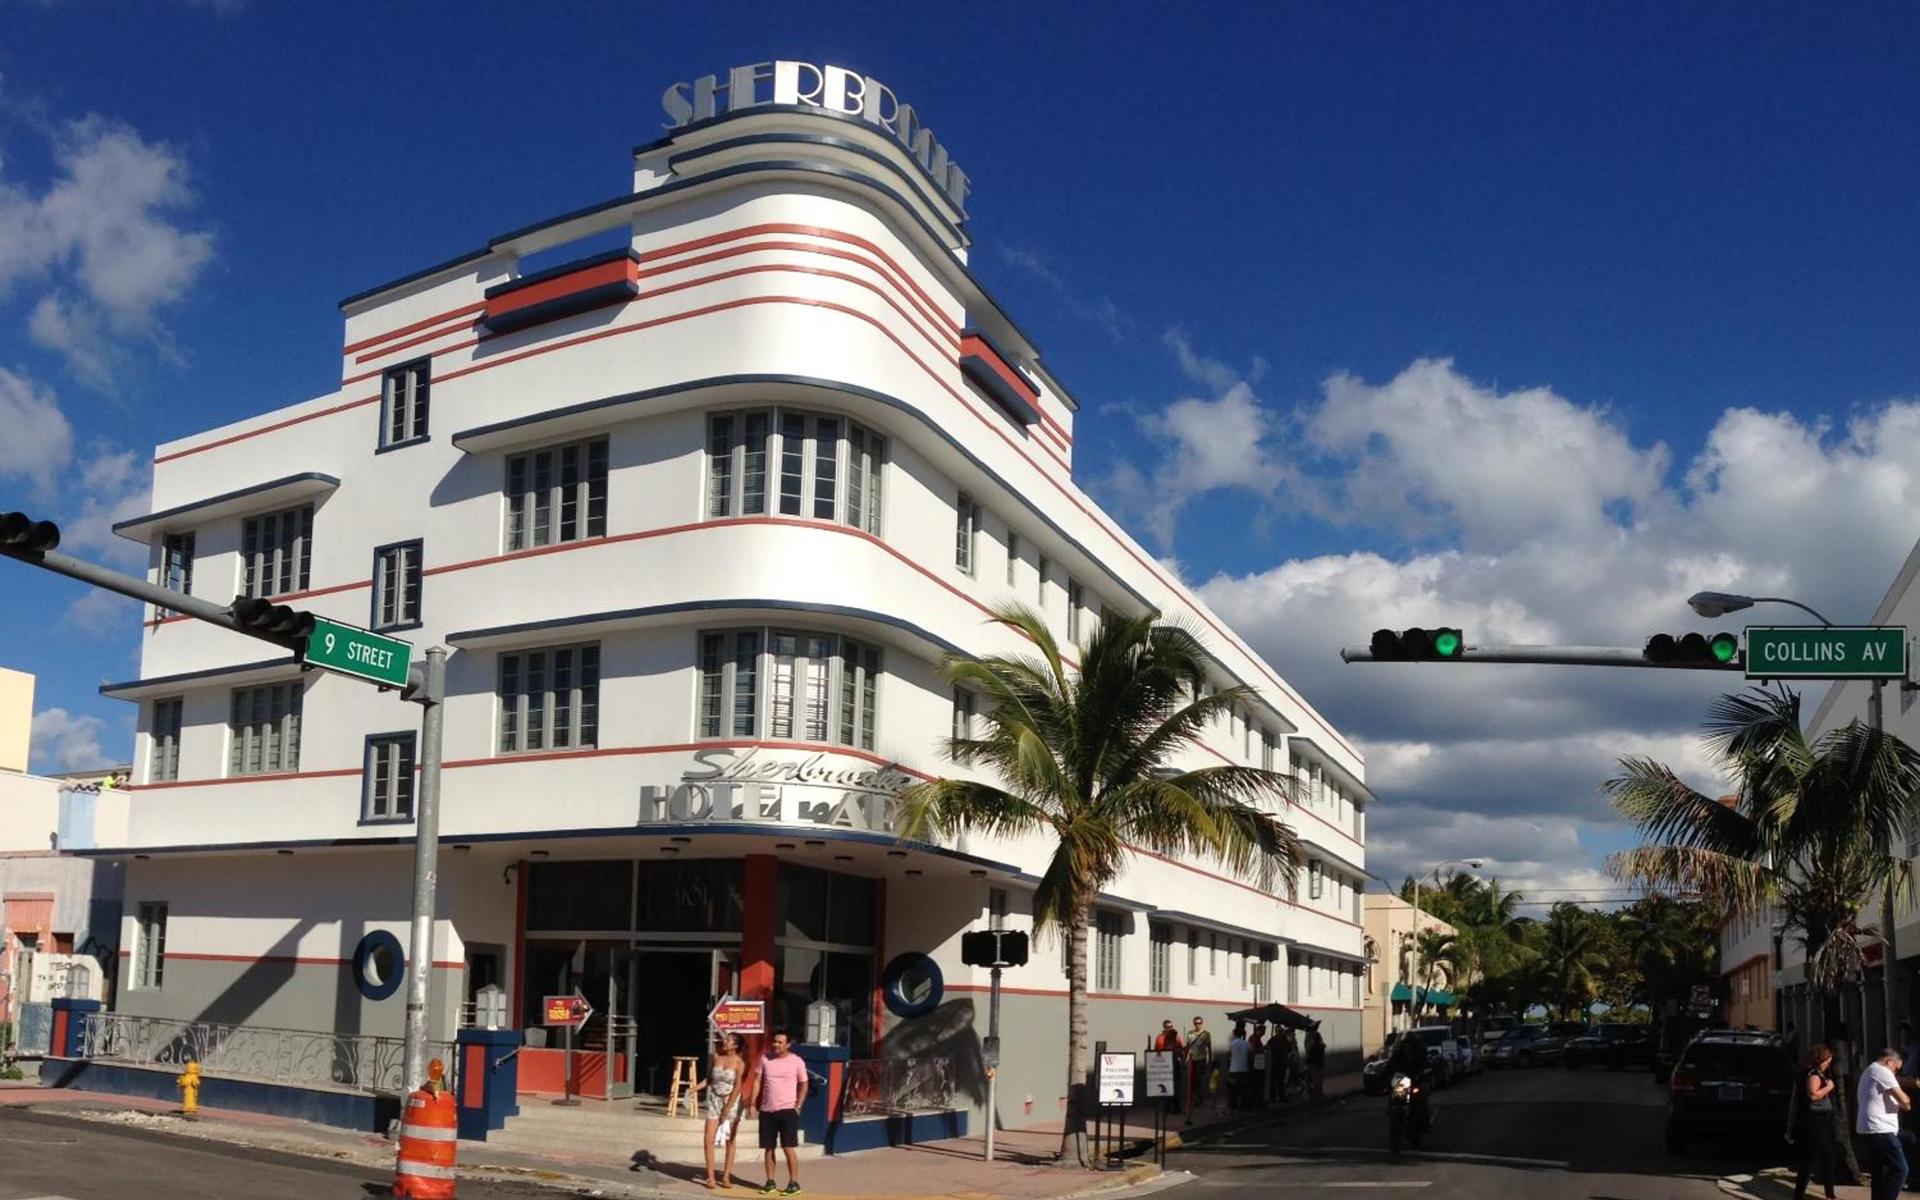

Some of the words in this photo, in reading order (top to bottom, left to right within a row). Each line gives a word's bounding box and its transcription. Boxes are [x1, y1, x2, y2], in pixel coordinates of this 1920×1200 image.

[325, 633, 336, 655] 9
[347, 641, 394, 670] STREET
[1764, 642, 1846, 662] COLLINS
[1862, 642, 1887, 662] AV
[639, 783, 815, 825] HOTEL
